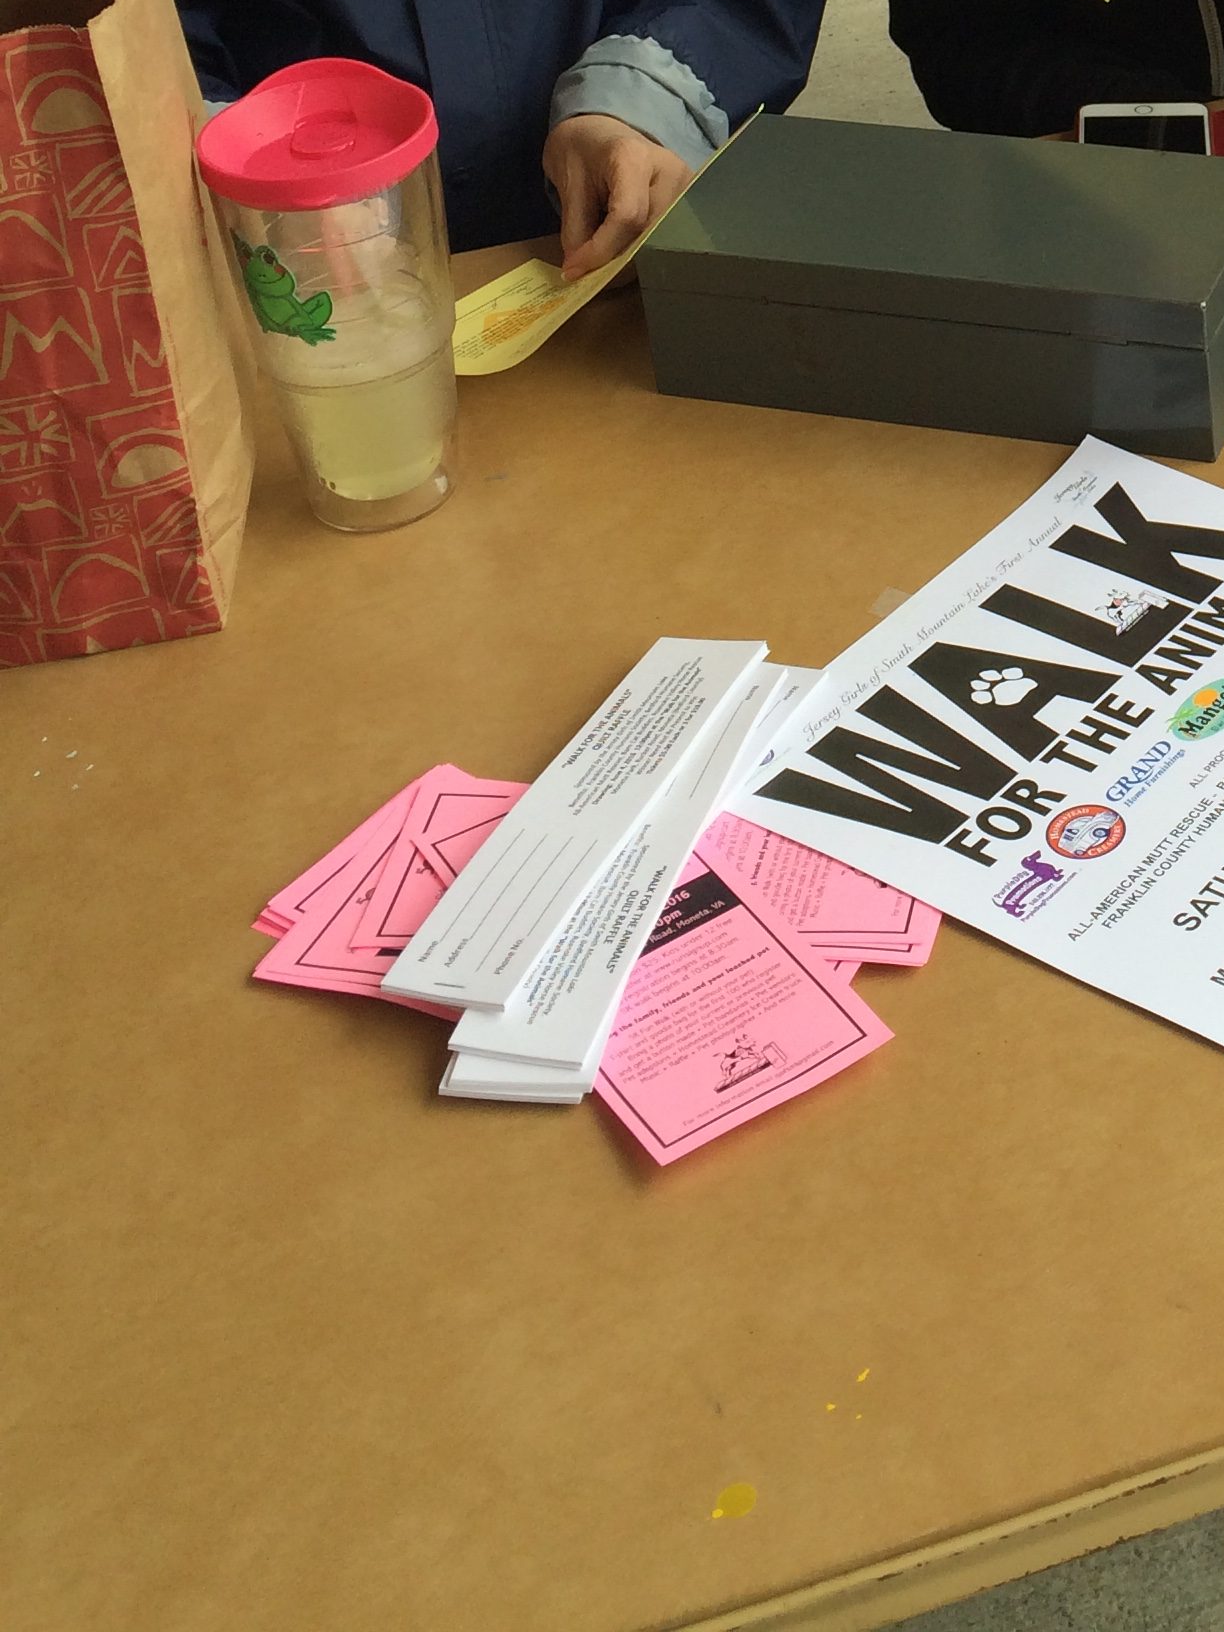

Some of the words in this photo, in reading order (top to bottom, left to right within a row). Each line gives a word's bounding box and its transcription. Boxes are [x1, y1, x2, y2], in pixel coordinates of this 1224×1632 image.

[947, 776, 1065, 867] FOR
[1040, 692, 1154, 776] THE
[1104, 739, 1175, 804] GRAND
[1123, 786, 1147, 807] Home
[1141, 747, 1186, 787] Furnishings
[1188, 772, 1208, 788] ALL
[1067, 865, 1146, 941] ALL-AMERICAN
[1141, 837, 1173, 866] MUTT
[1169, 797, 1214, 838] RESCUE
[1101, 876, 1157, 928] FRANKLIN
[1152, 835, 1196, 877] COUNTY
[618, 886, 640, 915] QUILT
[648, 924, 676, 944] Road,
[674, 904, 713, 930] Moneta,
[710, 898, 726, 910] VA
[653, 908, 683, 928] 0pm
[602, 912, 626, 947] RAFFLE
